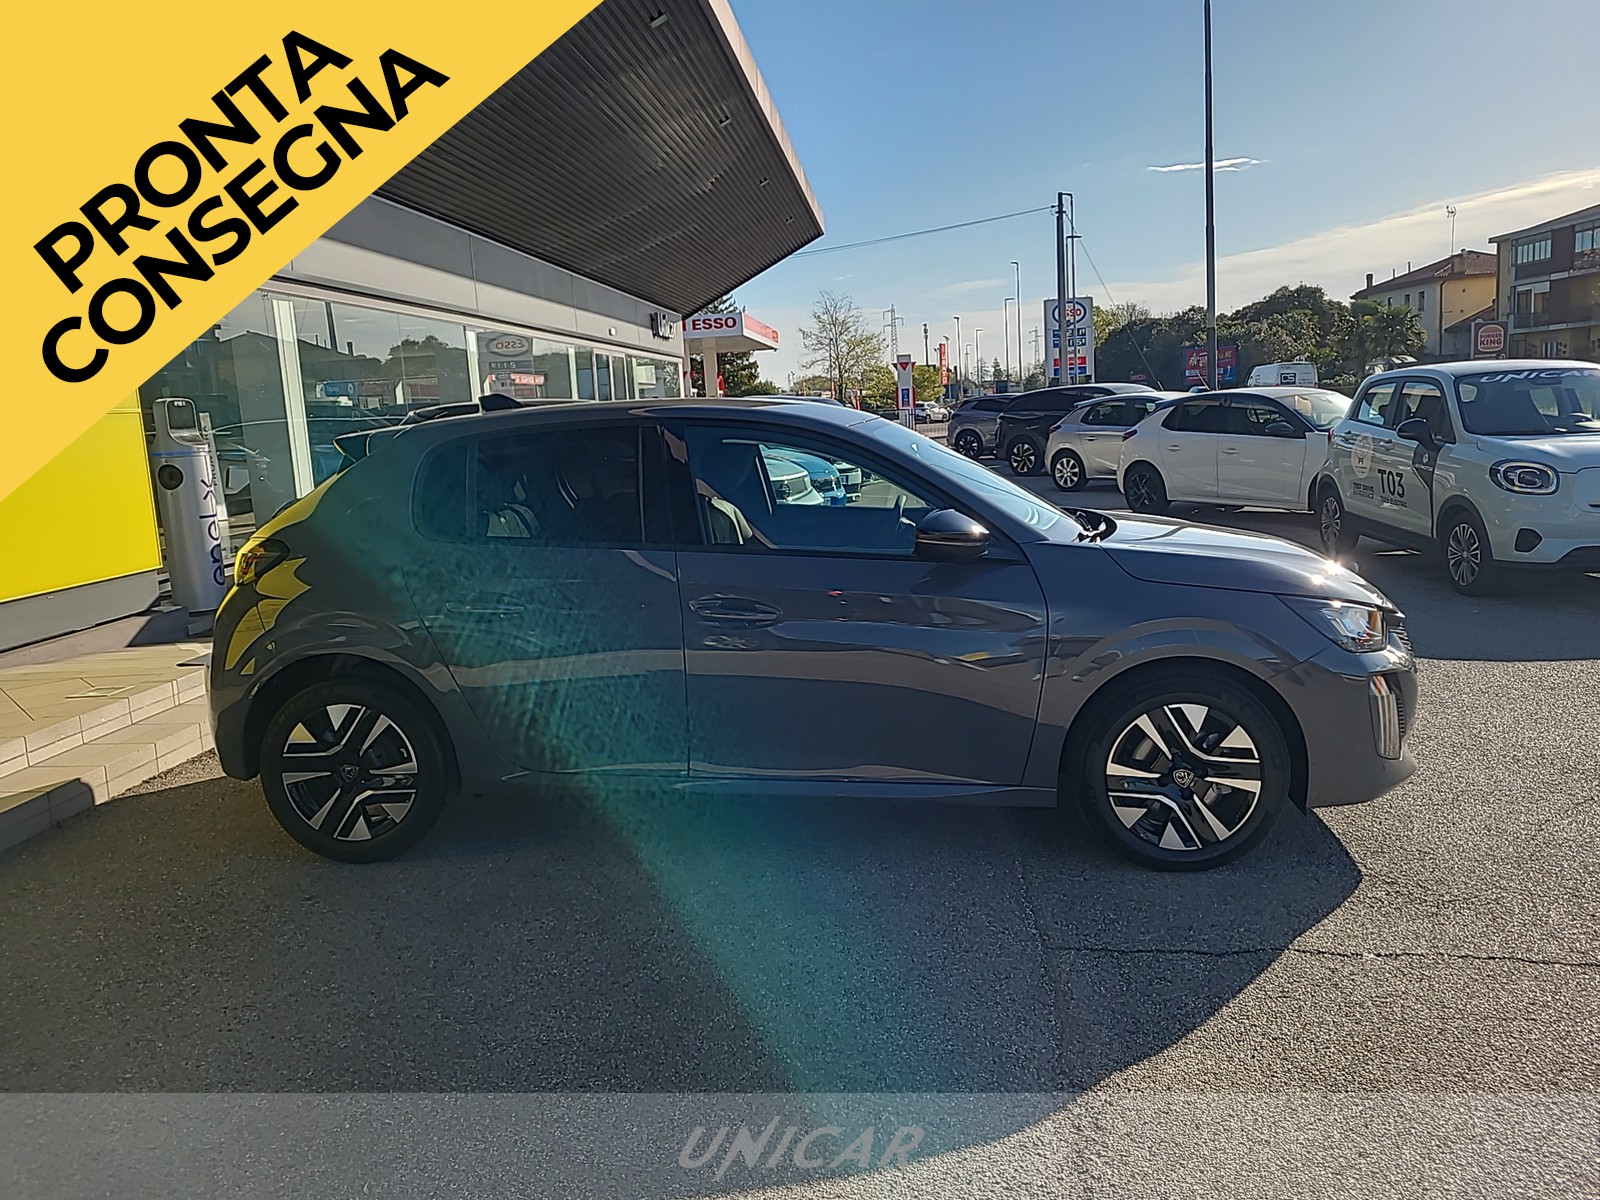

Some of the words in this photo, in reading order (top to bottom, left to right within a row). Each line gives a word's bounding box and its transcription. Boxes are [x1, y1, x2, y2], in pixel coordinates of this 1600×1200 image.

[692, 316, 737, 331] ESSO
[1480, 338, 1502, 346] KING
[1377, 468, 1405, 499] T03
